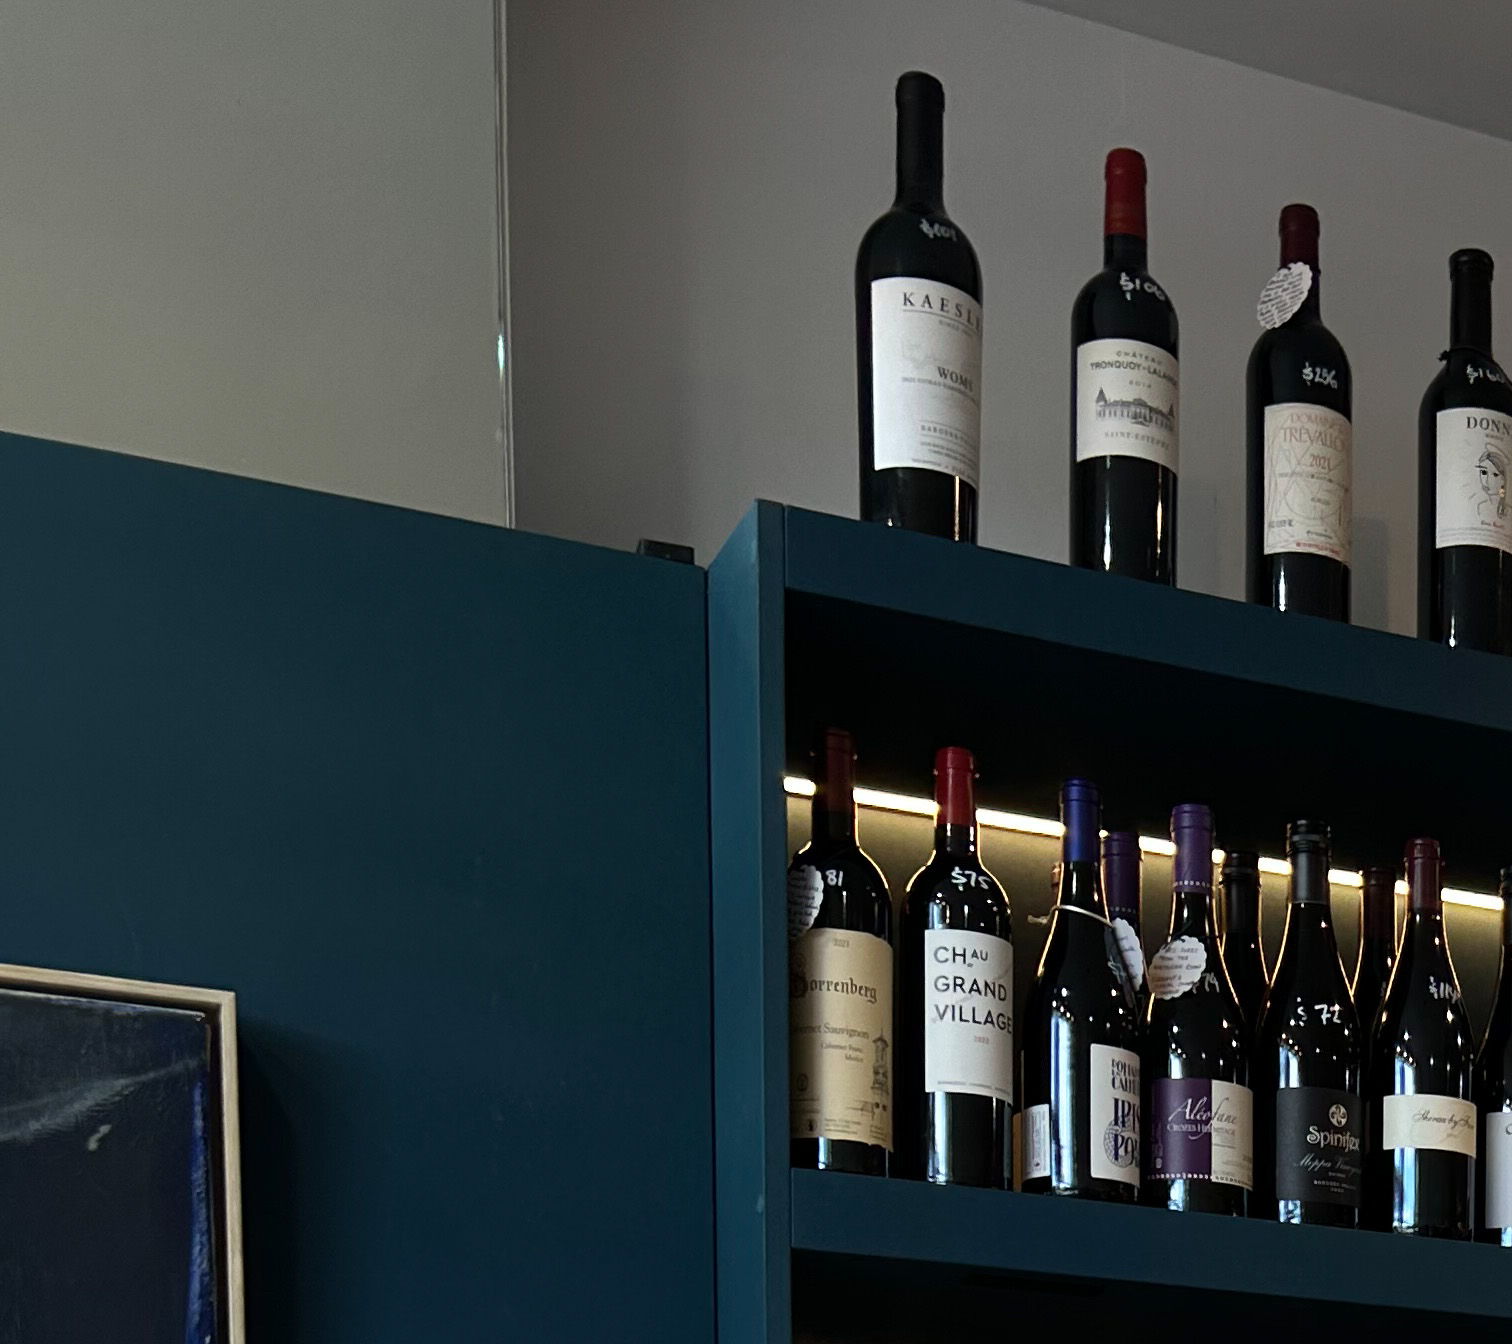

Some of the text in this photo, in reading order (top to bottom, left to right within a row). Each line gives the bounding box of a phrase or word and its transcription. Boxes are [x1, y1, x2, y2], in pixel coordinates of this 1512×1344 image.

[934, 974, 1008, 1002] GRAND
[934, 1004, 1013, 1035] VILLAGE
[1306, 1124, 1361, 1154] Spinifex
